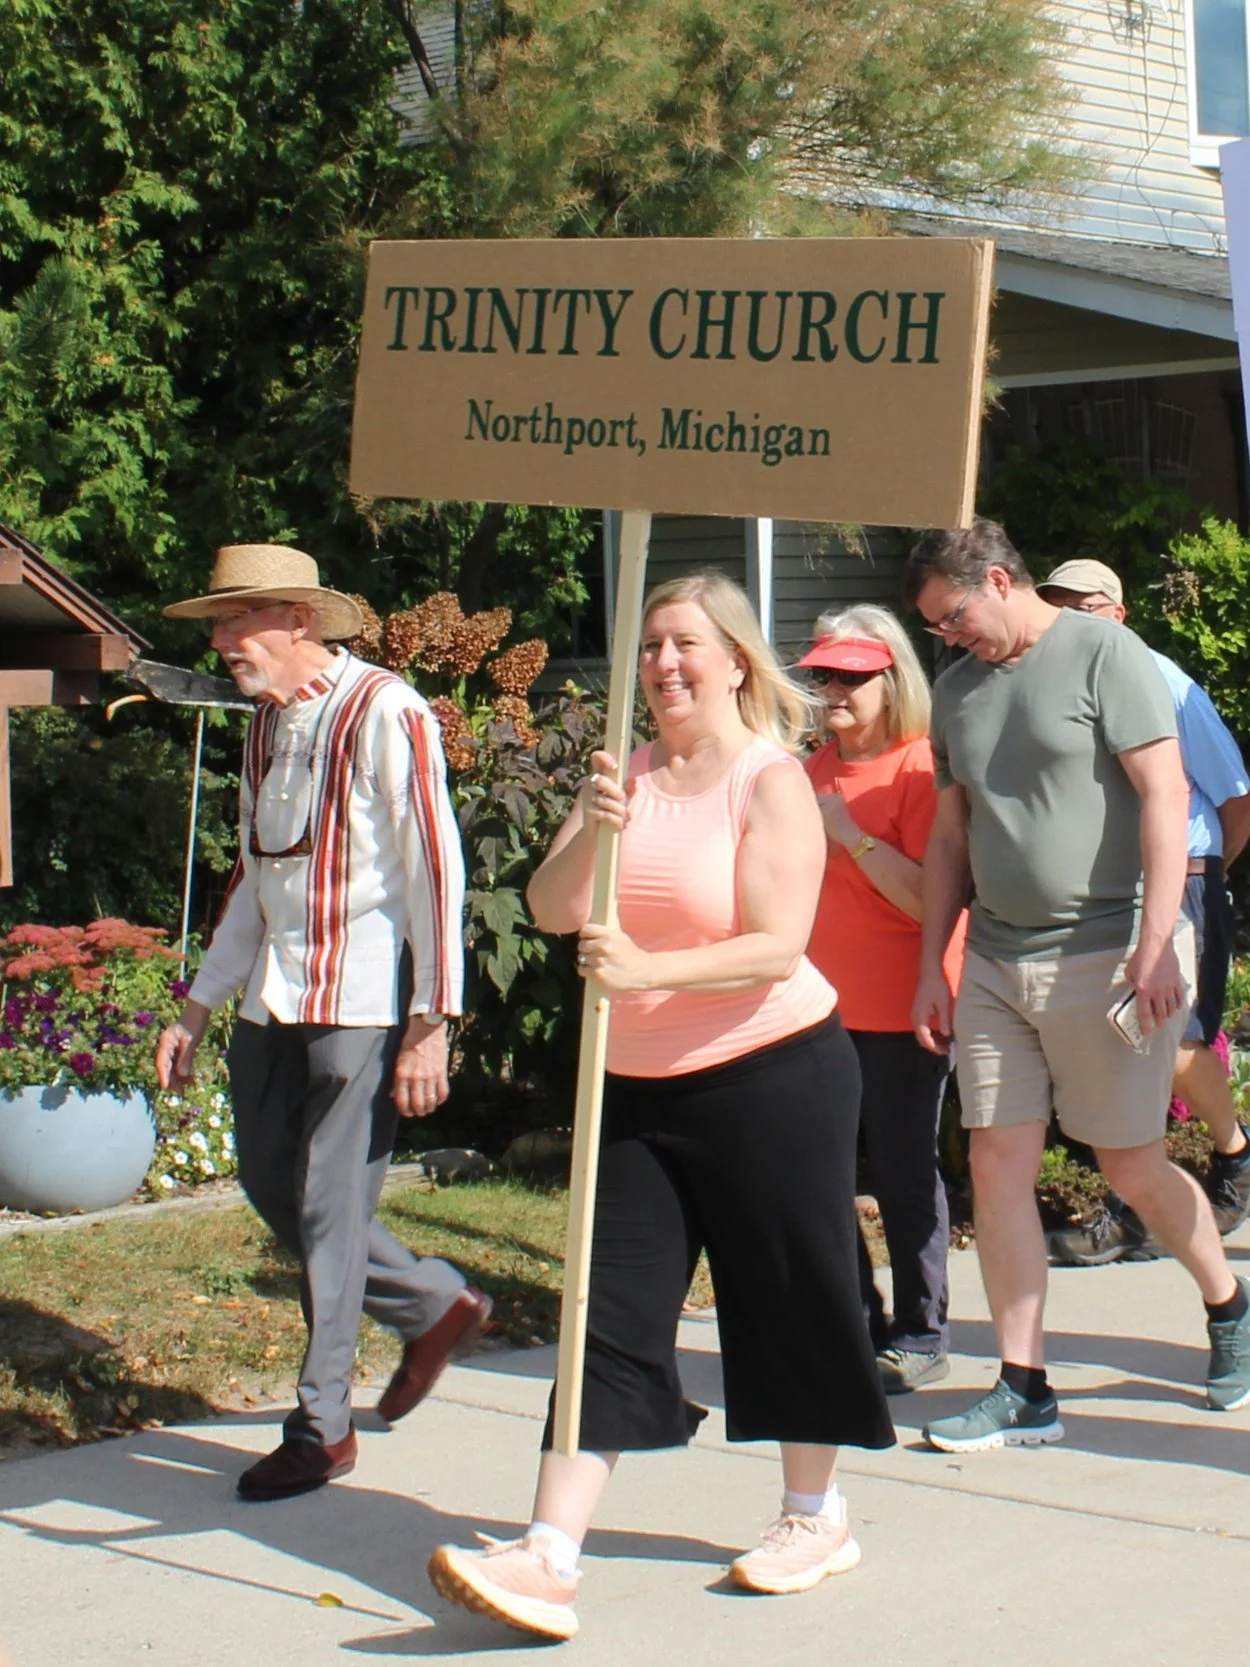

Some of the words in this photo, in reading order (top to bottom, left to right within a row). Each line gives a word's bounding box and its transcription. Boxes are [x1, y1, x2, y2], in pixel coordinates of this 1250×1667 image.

[384, 286, 635, 357] TRINITY
[649, 287, 946, 364] CHURCH
[464, 399, 647, 456] Northport,
[656, 407, 832, 467] Michigan
